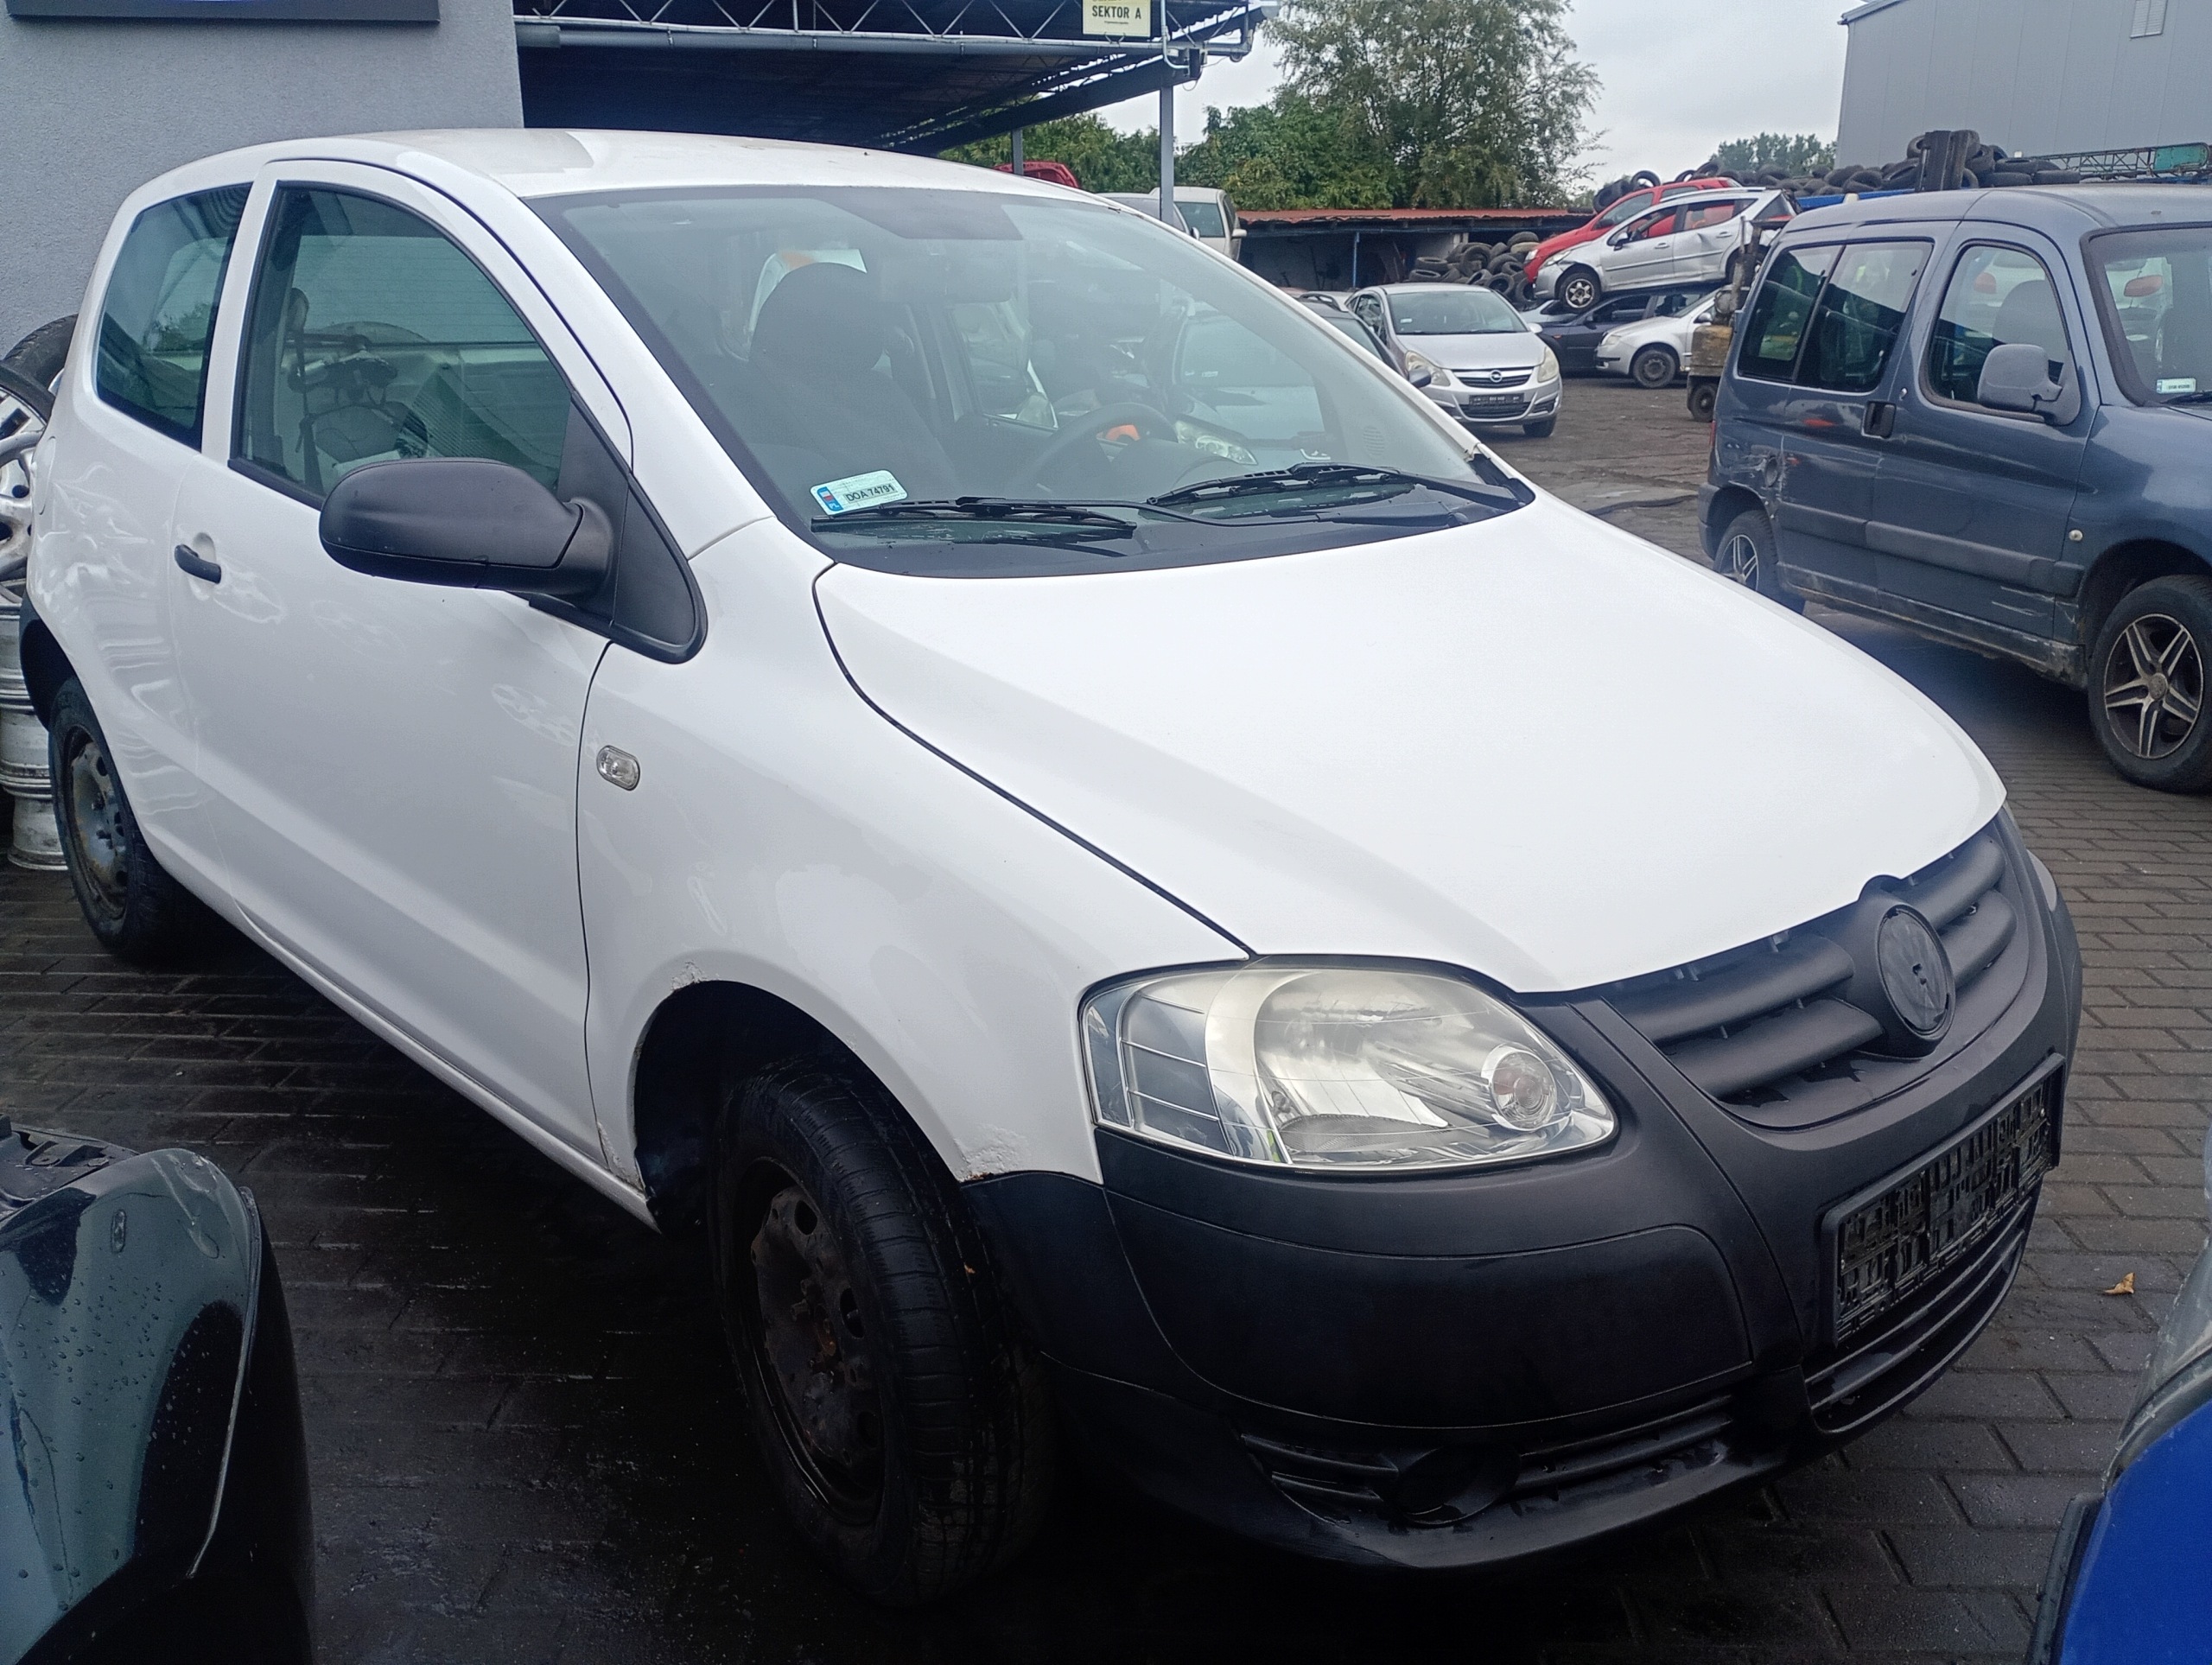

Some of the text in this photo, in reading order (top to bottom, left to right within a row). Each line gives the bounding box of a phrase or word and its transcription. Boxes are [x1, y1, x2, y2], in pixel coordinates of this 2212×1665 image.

[1091, 5, 1141, 19] SEKTOR A
[846, 490, 869, 501] DOA
